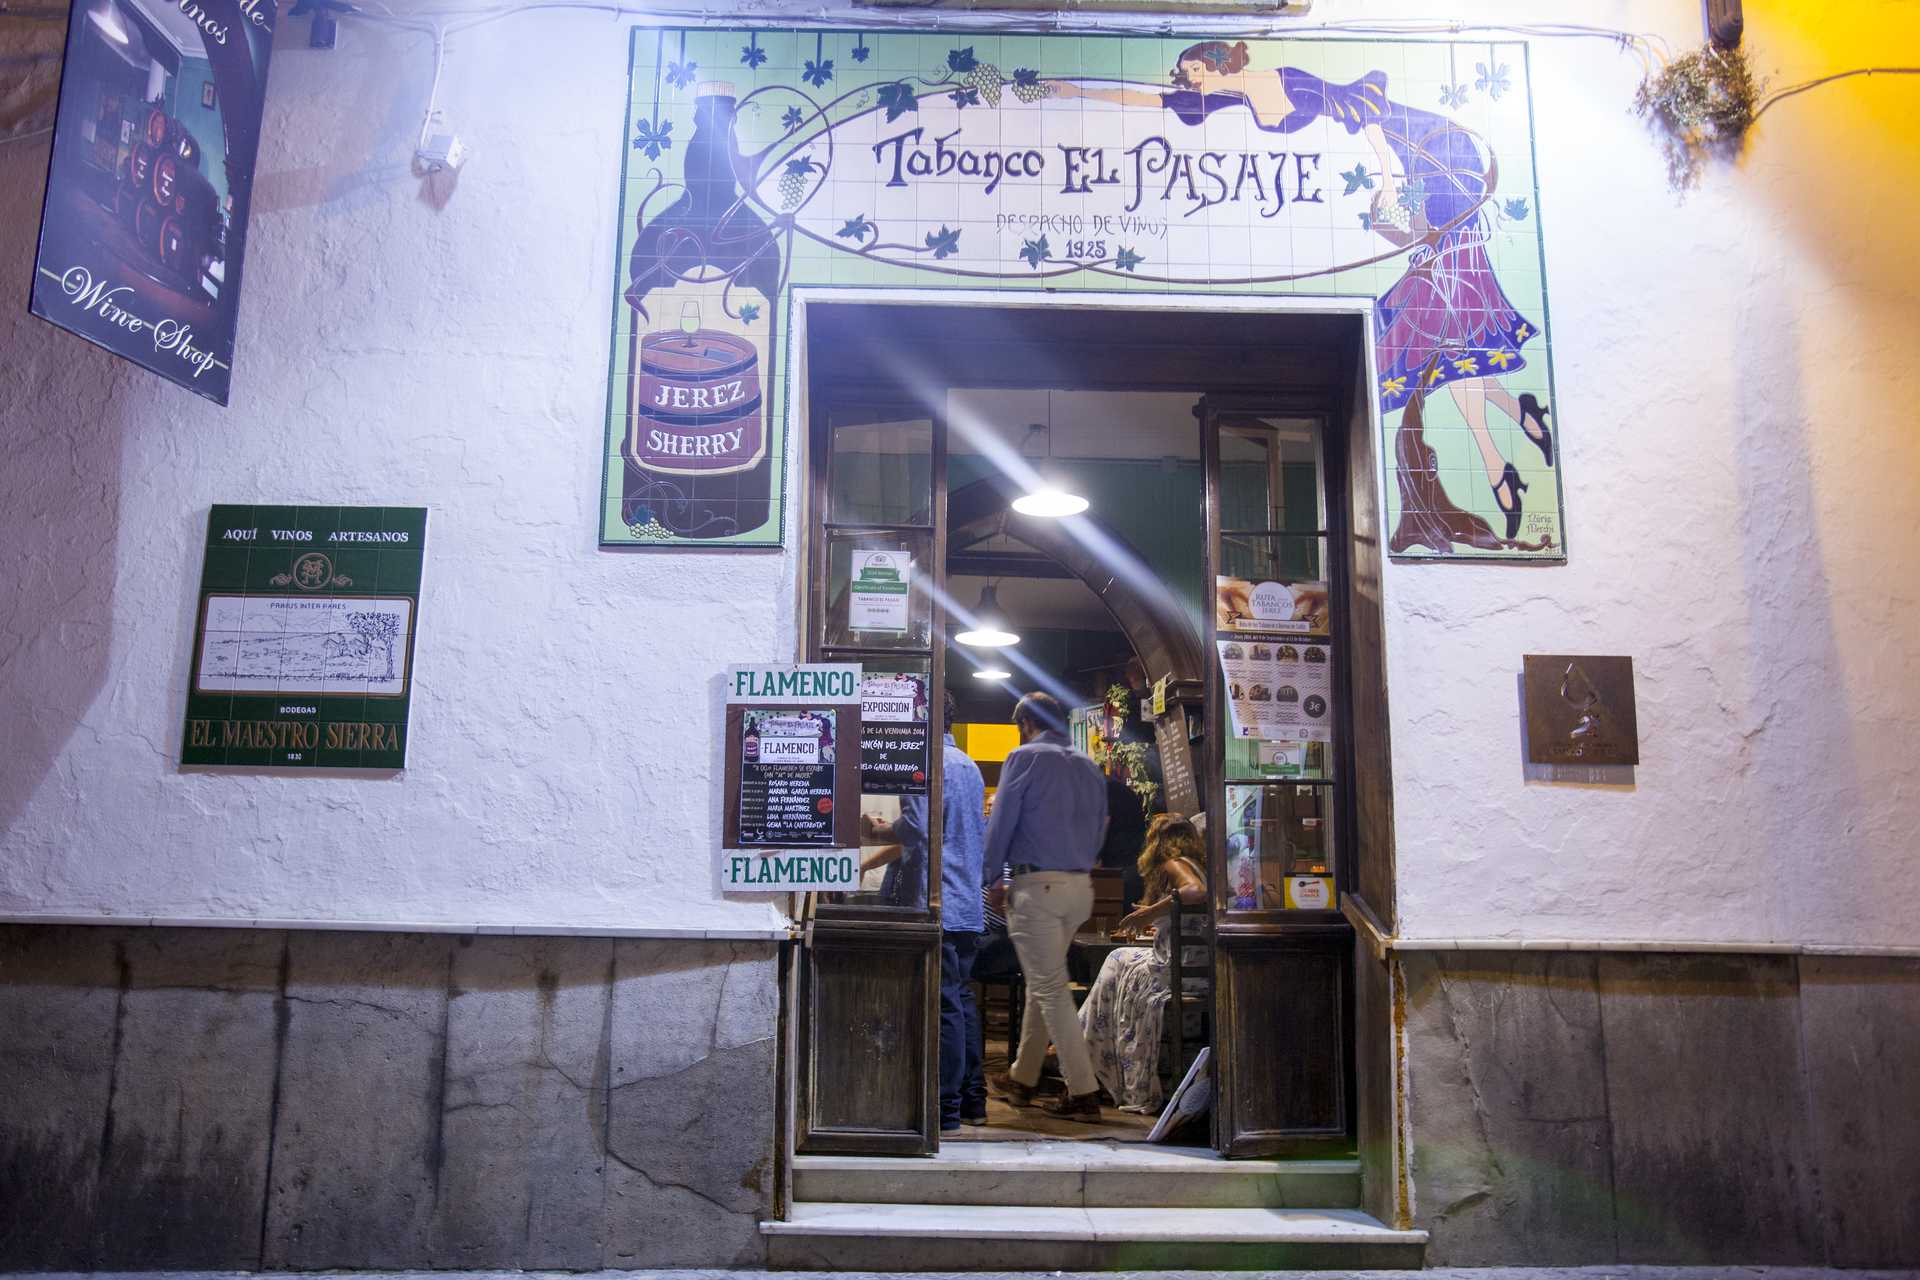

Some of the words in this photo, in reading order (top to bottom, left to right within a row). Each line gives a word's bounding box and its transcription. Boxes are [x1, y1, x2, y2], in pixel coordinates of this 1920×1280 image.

[872, 127, 1045, 195] Tabanco
[1124, 135, 1324, 217] PASAJE
[996, 214, 1083, 236] DESPACHO
[1093, 215, 1115, 236] DE
[1119, 215, 1168, 240] VINOS
[1066, 240, 1106, 259] 1925
[61, 266, 142, 333] Wine
[154, 319, 215, 378] Shop
[655, 380, 746, 408] JEREZ
[646, 427, 744, 457] SHERRY
[223, 528, 258, 541] AQUÍ
[271, 530, 313, 541] VINOS
[328, 531, 409, 542] ARTESANOS
[736, 671, 855, 697] FLAMENCO
[280, 706, 316, 714] BODEGAS
[862, 700, 910, 713] EXPOSICIÓN
[190, 719, 215, 748] EL
[222, 719, 320, 750] MAESTRO
[326, 722, 400, 751] SIERRA
[764, 742, 815, 754] FLAMENCO
[885, 741, 898, 749] DEL
[731, 857, 851, 884] FLAMENCO
